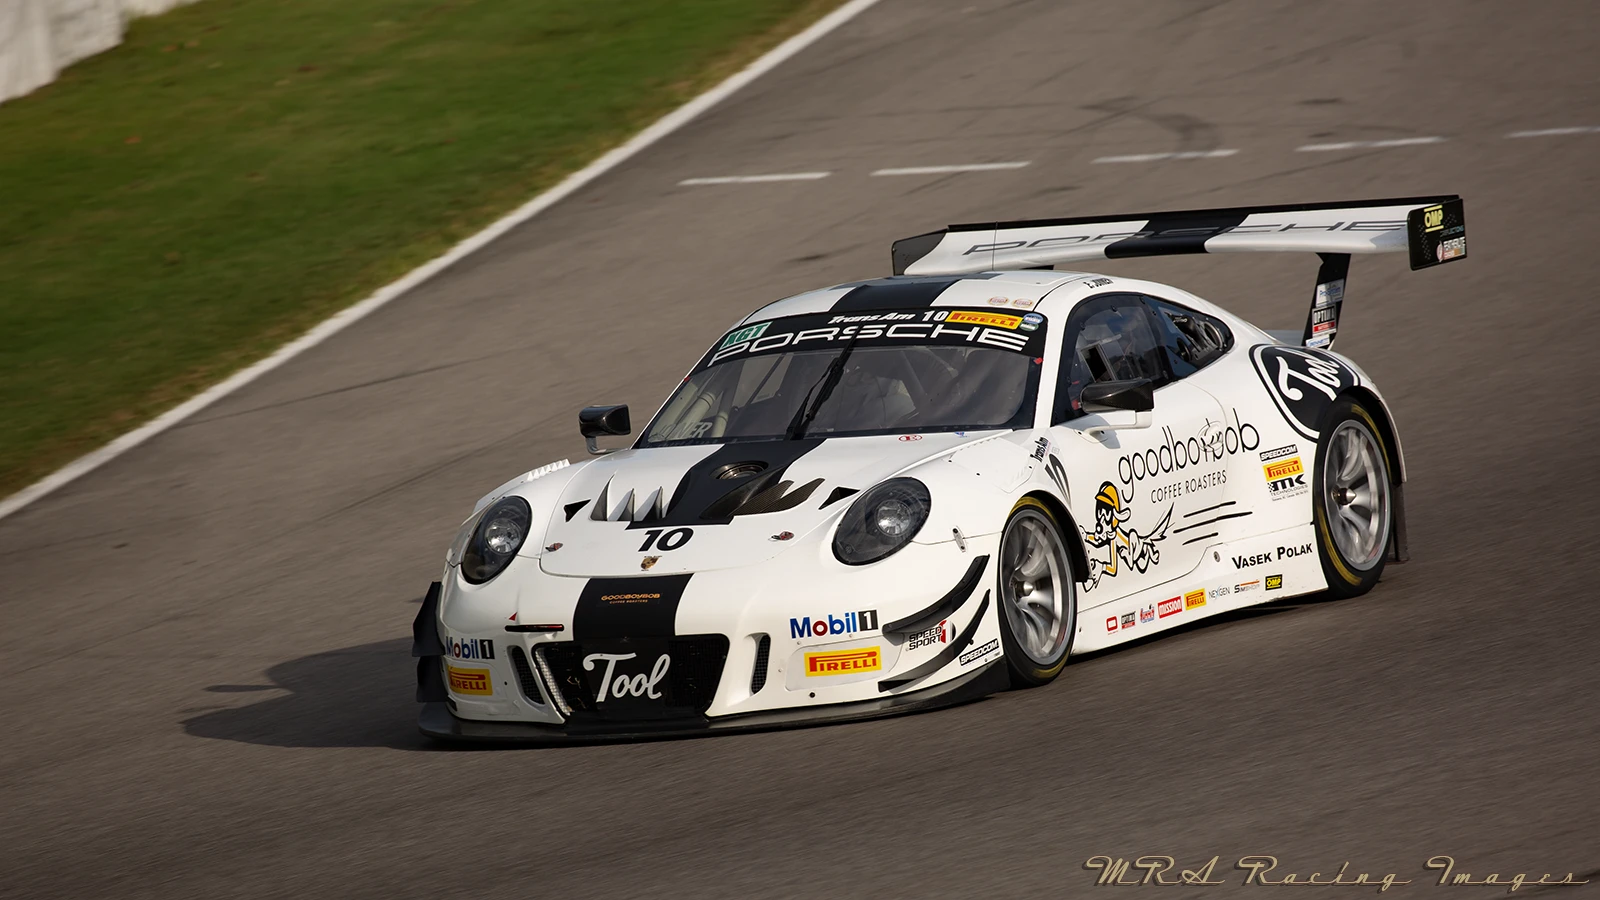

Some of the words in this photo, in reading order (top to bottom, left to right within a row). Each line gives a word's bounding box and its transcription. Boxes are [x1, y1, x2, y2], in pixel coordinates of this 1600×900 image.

[1424, 209, 1443, 228] OMP
[962, 219, 1408, 255] PORSCHE
[922, 310, 950, 323] 10
[951, 312, 1019, 327] PIRELLI
[707, 323, 1030, 367] PORSCHE
[1275, 347, 1341, 401] Tool
[1260, 445, 1298, 461] SPEEDCOM
[1267, 460, 1300, 478] PIRELLI
[1151, 481, 1182, 503] COFFEE
[1185, 470, 1227, 494] ROASTERS
[637, 527, 694, 552] 10
[1231, 552, 1273, 569] VASEK
[1277, 543, 1313, 560] POLAK
[1266, 577, 1281, 588] OMP
[1159, 599, 1182, 617] MISSION
[1186, 592, 1205, 607] PIRELLI
[790, 611, 857, 639] Mobil
[908, 626, 942, 643] SPEED
[446, 636, 479, 659] Mobil
[908, 634, 942, 650] SPORT
[960, 639, 999, 665] SPEEDCOM
[809, 651, 878, 673] PIRELLI
[582, 652, 671, 703] Tool
